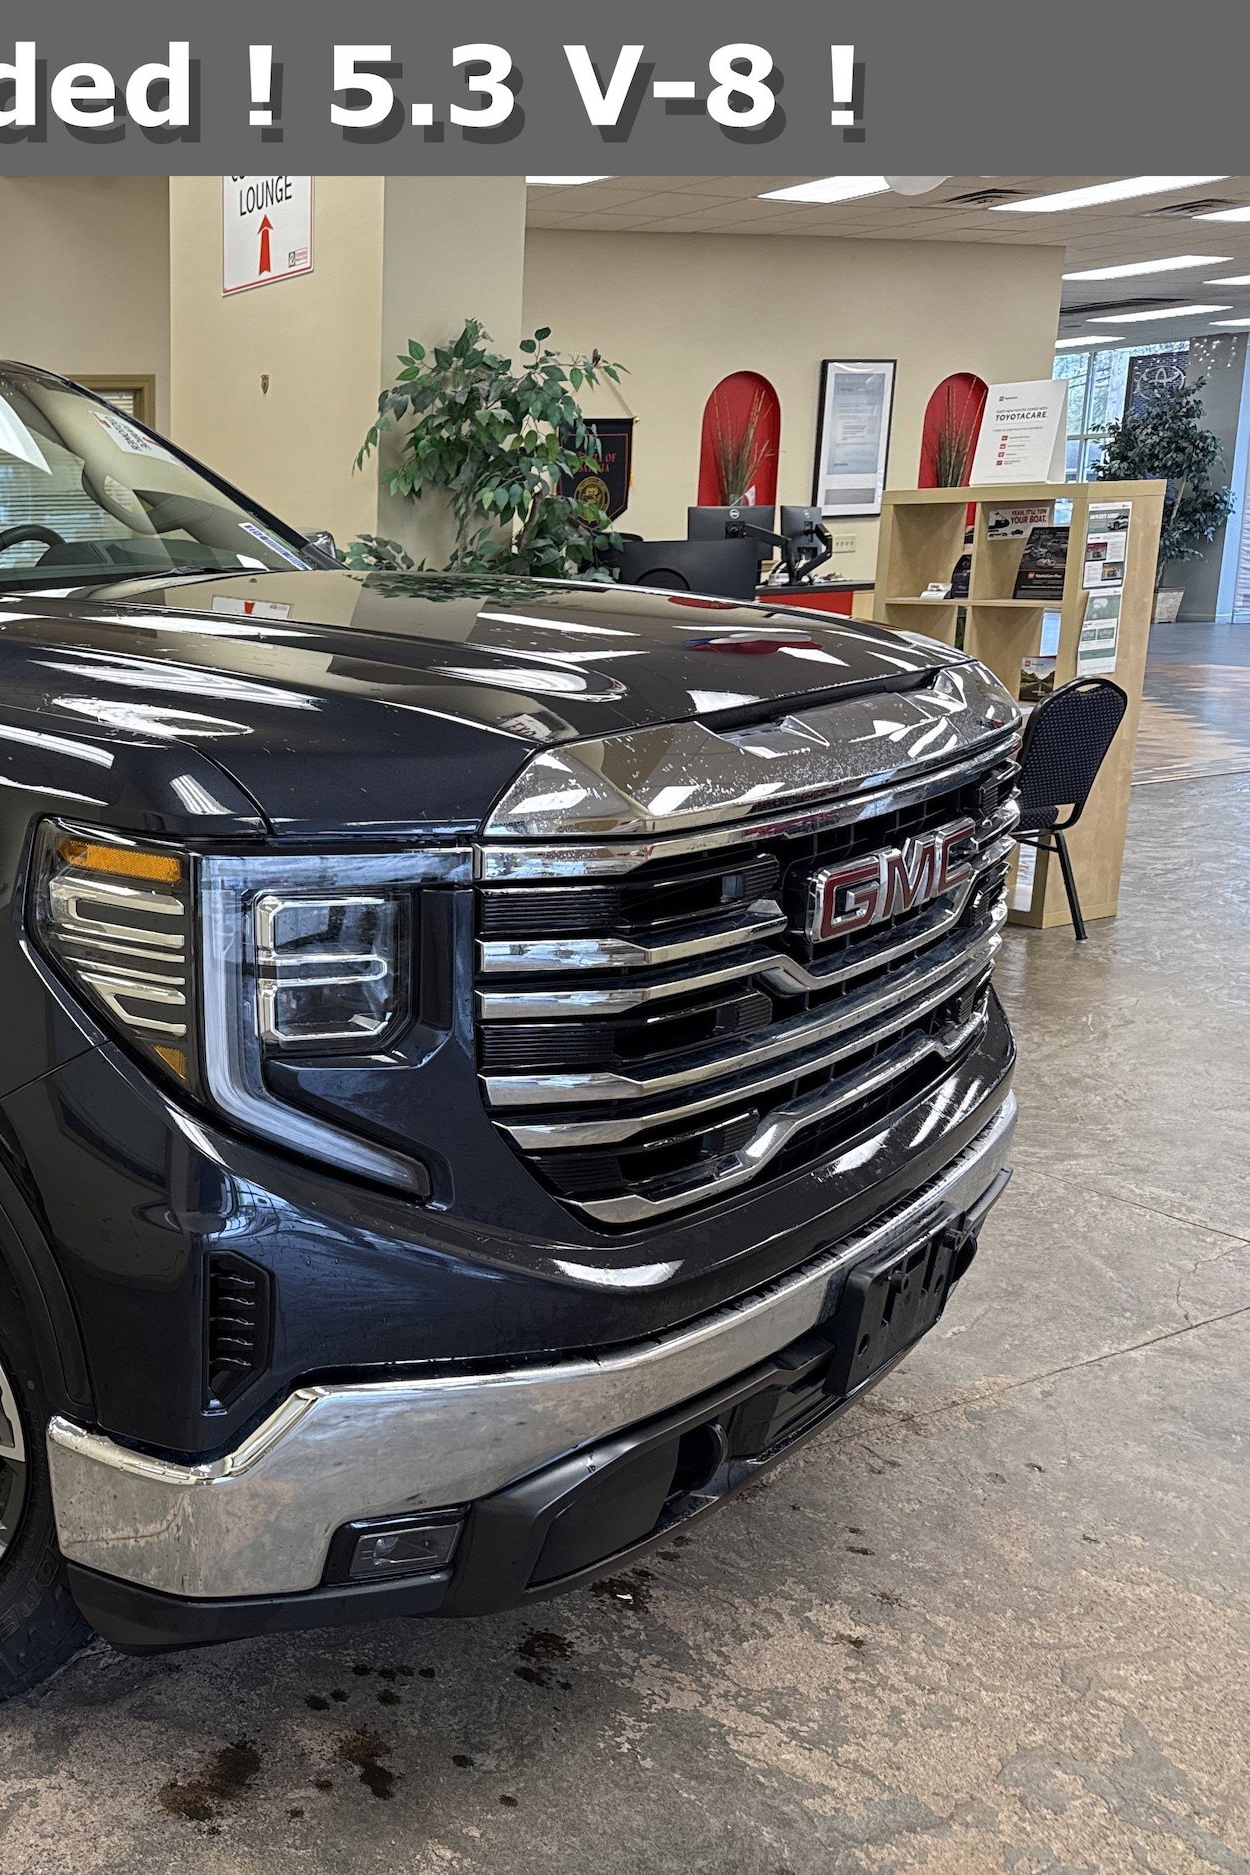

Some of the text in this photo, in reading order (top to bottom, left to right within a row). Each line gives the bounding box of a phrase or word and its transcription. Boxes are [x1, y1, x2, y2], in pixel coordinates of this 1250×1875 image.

[240, 176, 292, 216] LOUNGE
[995, 411, 1047, 421] TOYOTACARE
[1011, 516, 1028, 524] YOUR
[810, 817, 976, 944] GMC
